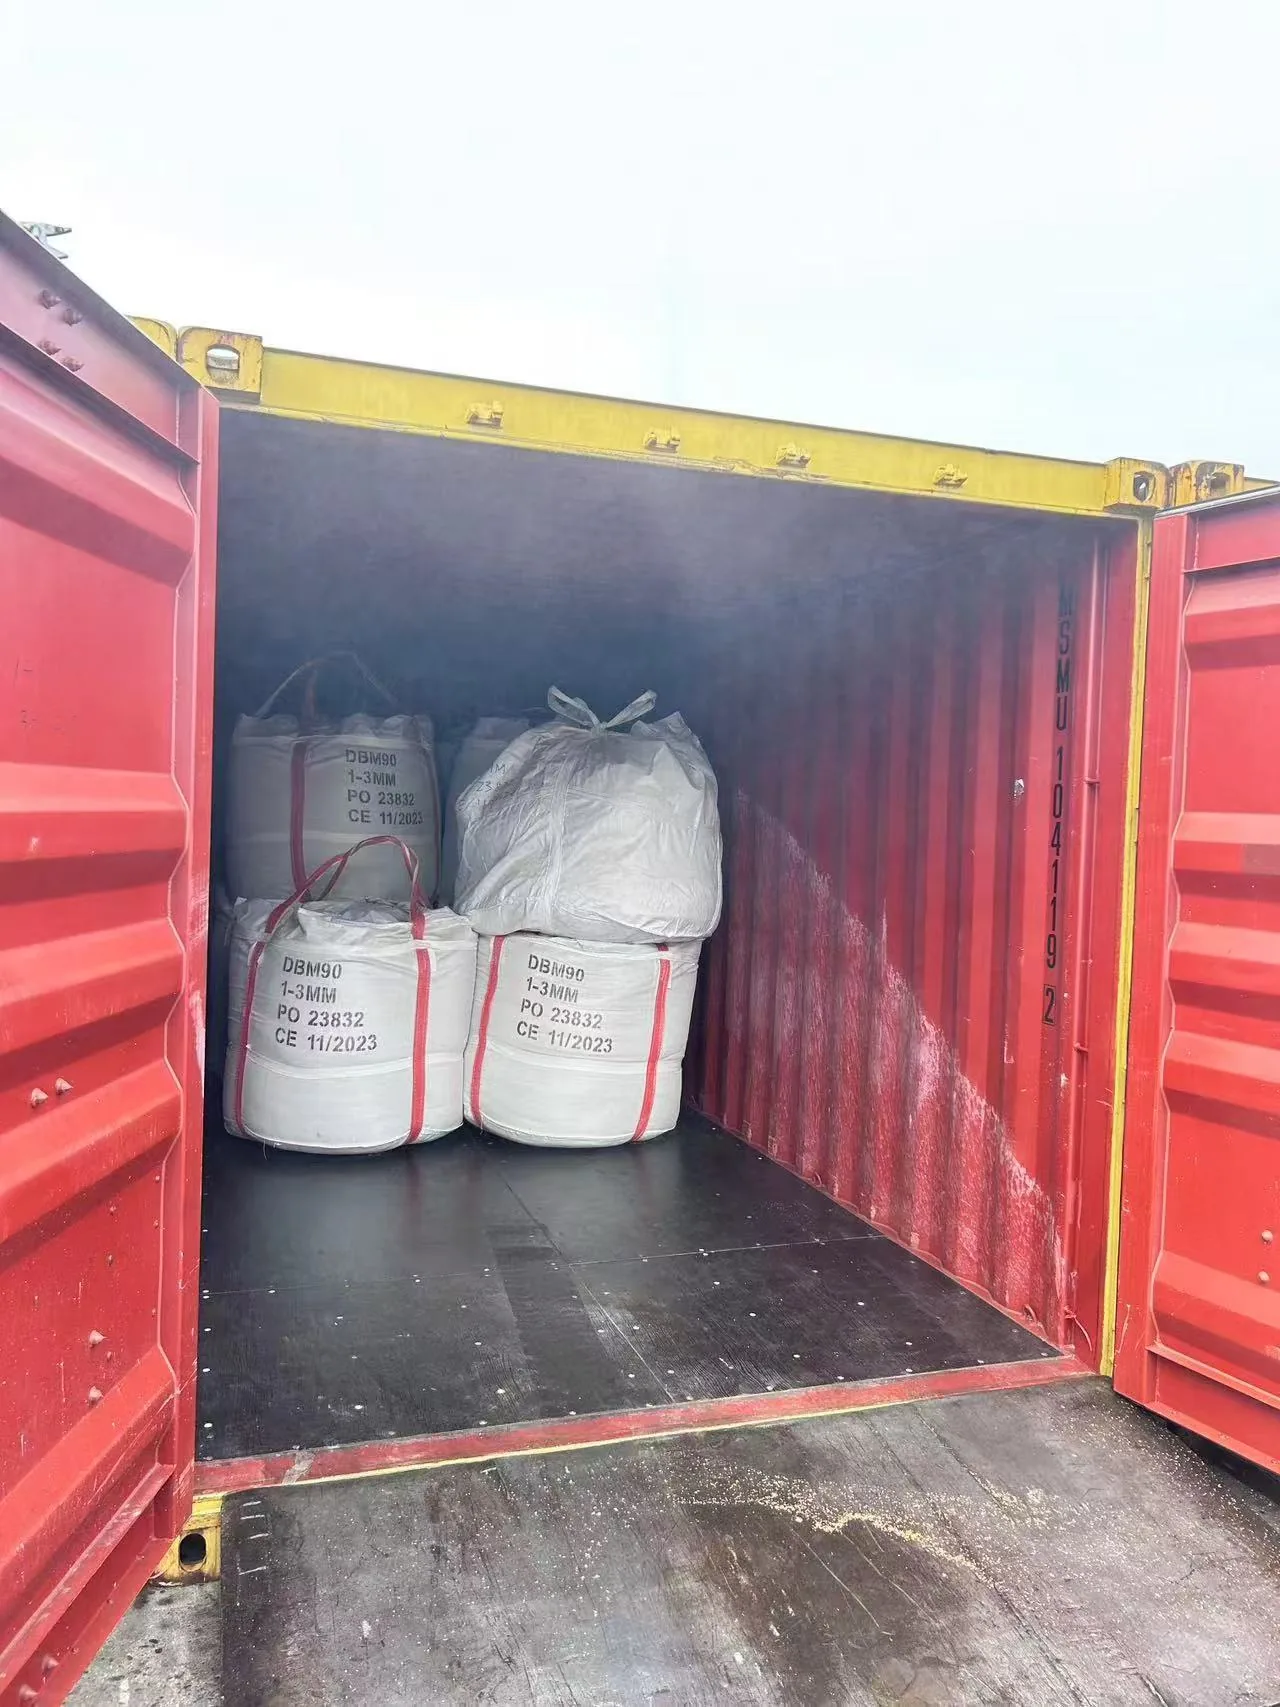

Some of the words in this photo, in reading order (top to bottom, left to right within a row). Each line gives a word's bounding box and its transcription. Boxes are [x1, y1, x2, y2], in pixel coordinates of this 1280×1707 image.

[345, 749, 397, 767] DBM90
[347, 769, 396, 787] 1-3MM
[347, 789, 371, 804] PO
[378, 791, 415, 807] 23832
[348, 809, 372, 823] CE
[380, 811, 424, 825] 11/2023
[1047, 745, 1063, 969] 104119
[282, 956, 342, 979] DBM90
[527, 954, 585, 982] DBM90
[281, 980, 337, 1003] 1-3MM
[527, 976, 579, 1003] 1-3MM
[277, 1003, 301, 1023] PO
[307, 1010, 364, 1028] 23832
[520, 998, 544, 1017] PO
[550, 1007, 603, 1029] 23832
[1044, 986, 1056, 1024] 2
[275, 1027, 298, 1048] CE
[307, 1034, 378, 1052] 11/2023
[516, 1020, 540, 1041] CE
[548, 1029, 613, 1053] 11/2023
